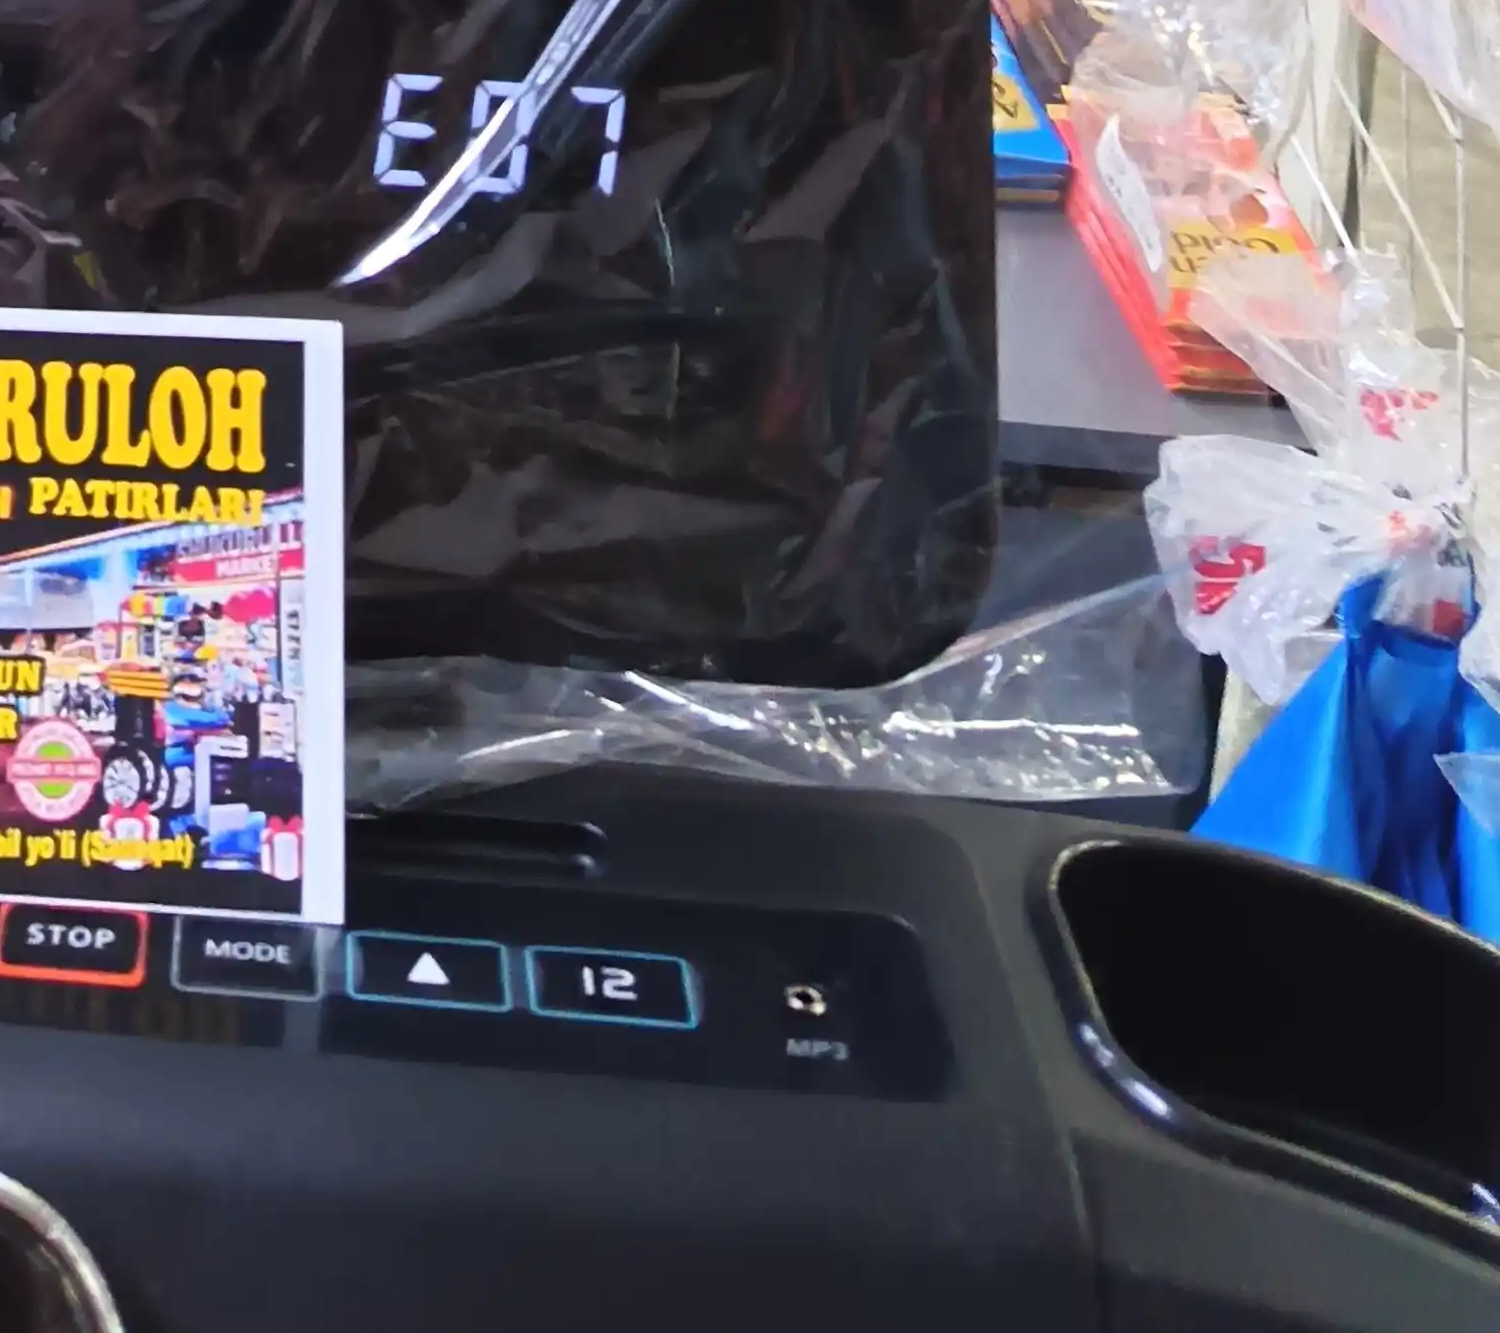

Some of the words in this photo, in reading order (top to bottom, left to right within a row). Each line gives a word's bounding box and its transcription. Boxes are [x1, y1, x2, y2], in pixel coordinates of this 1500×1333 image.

[29, 476, 267, 527] PATIRLARI
[26, 921, 117, 951] STOP
[204, 938, 293, 966] MODE
[581, 965, 639, 1002] 12
[786, 1038, 851, 1062] MP3
